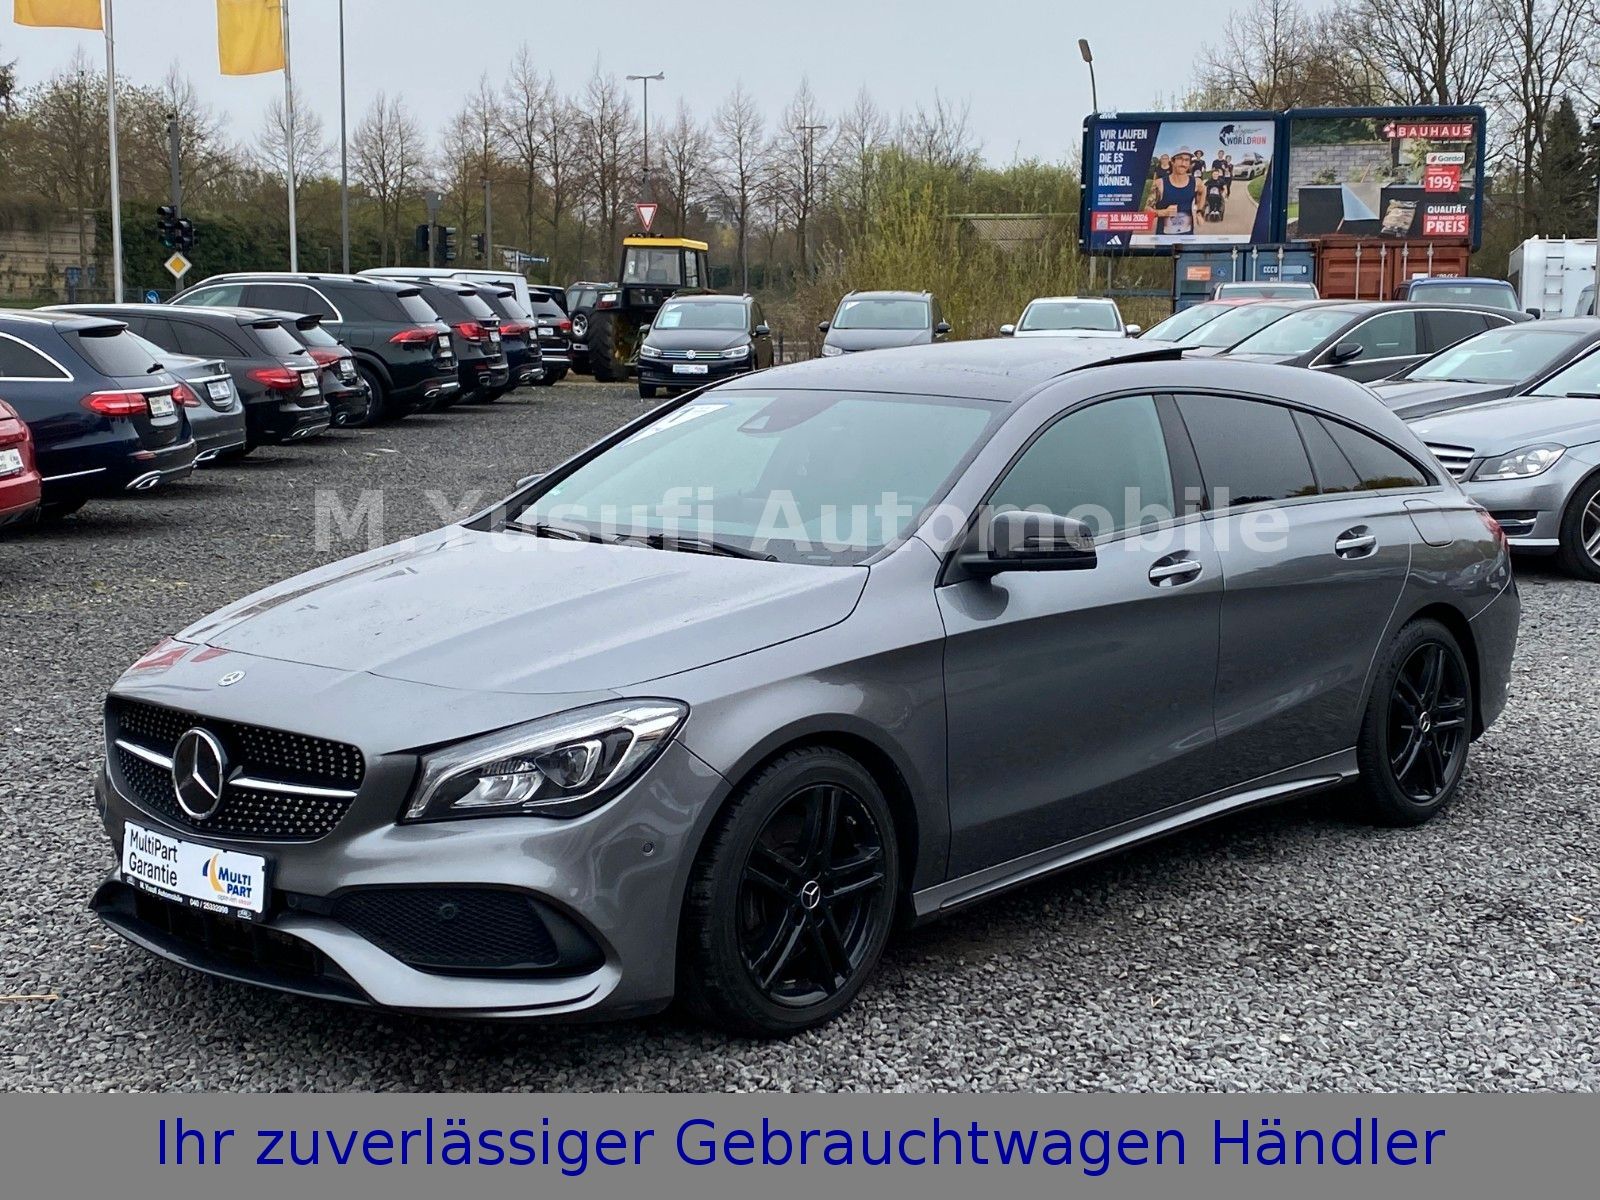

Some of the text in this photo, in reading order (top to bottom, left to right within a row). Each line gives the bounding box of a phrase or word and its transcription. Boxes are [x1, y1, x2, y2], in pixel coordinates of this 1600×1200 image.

[1100, 129, 1148, 140] WIR LAUFEN
[1398, 125, 1472, 136] BAUHAUS
[1100, 140, 1138, 152] FÜR ALLE,
[1099, 153, 1124, 163] DIE ES
[1099, 164, 1122, 175] NICHT
[1098, 174, 1132, 186] KÖNNEN.
[1427, 204, 1467, 214] QUALITÄT
[1426, 220, 1466, 233] PREIS
[130, 829, 178, 863] MultiPart
[129, 852, 178, 886] Garantie
[226, 883, 252, 899] PART
